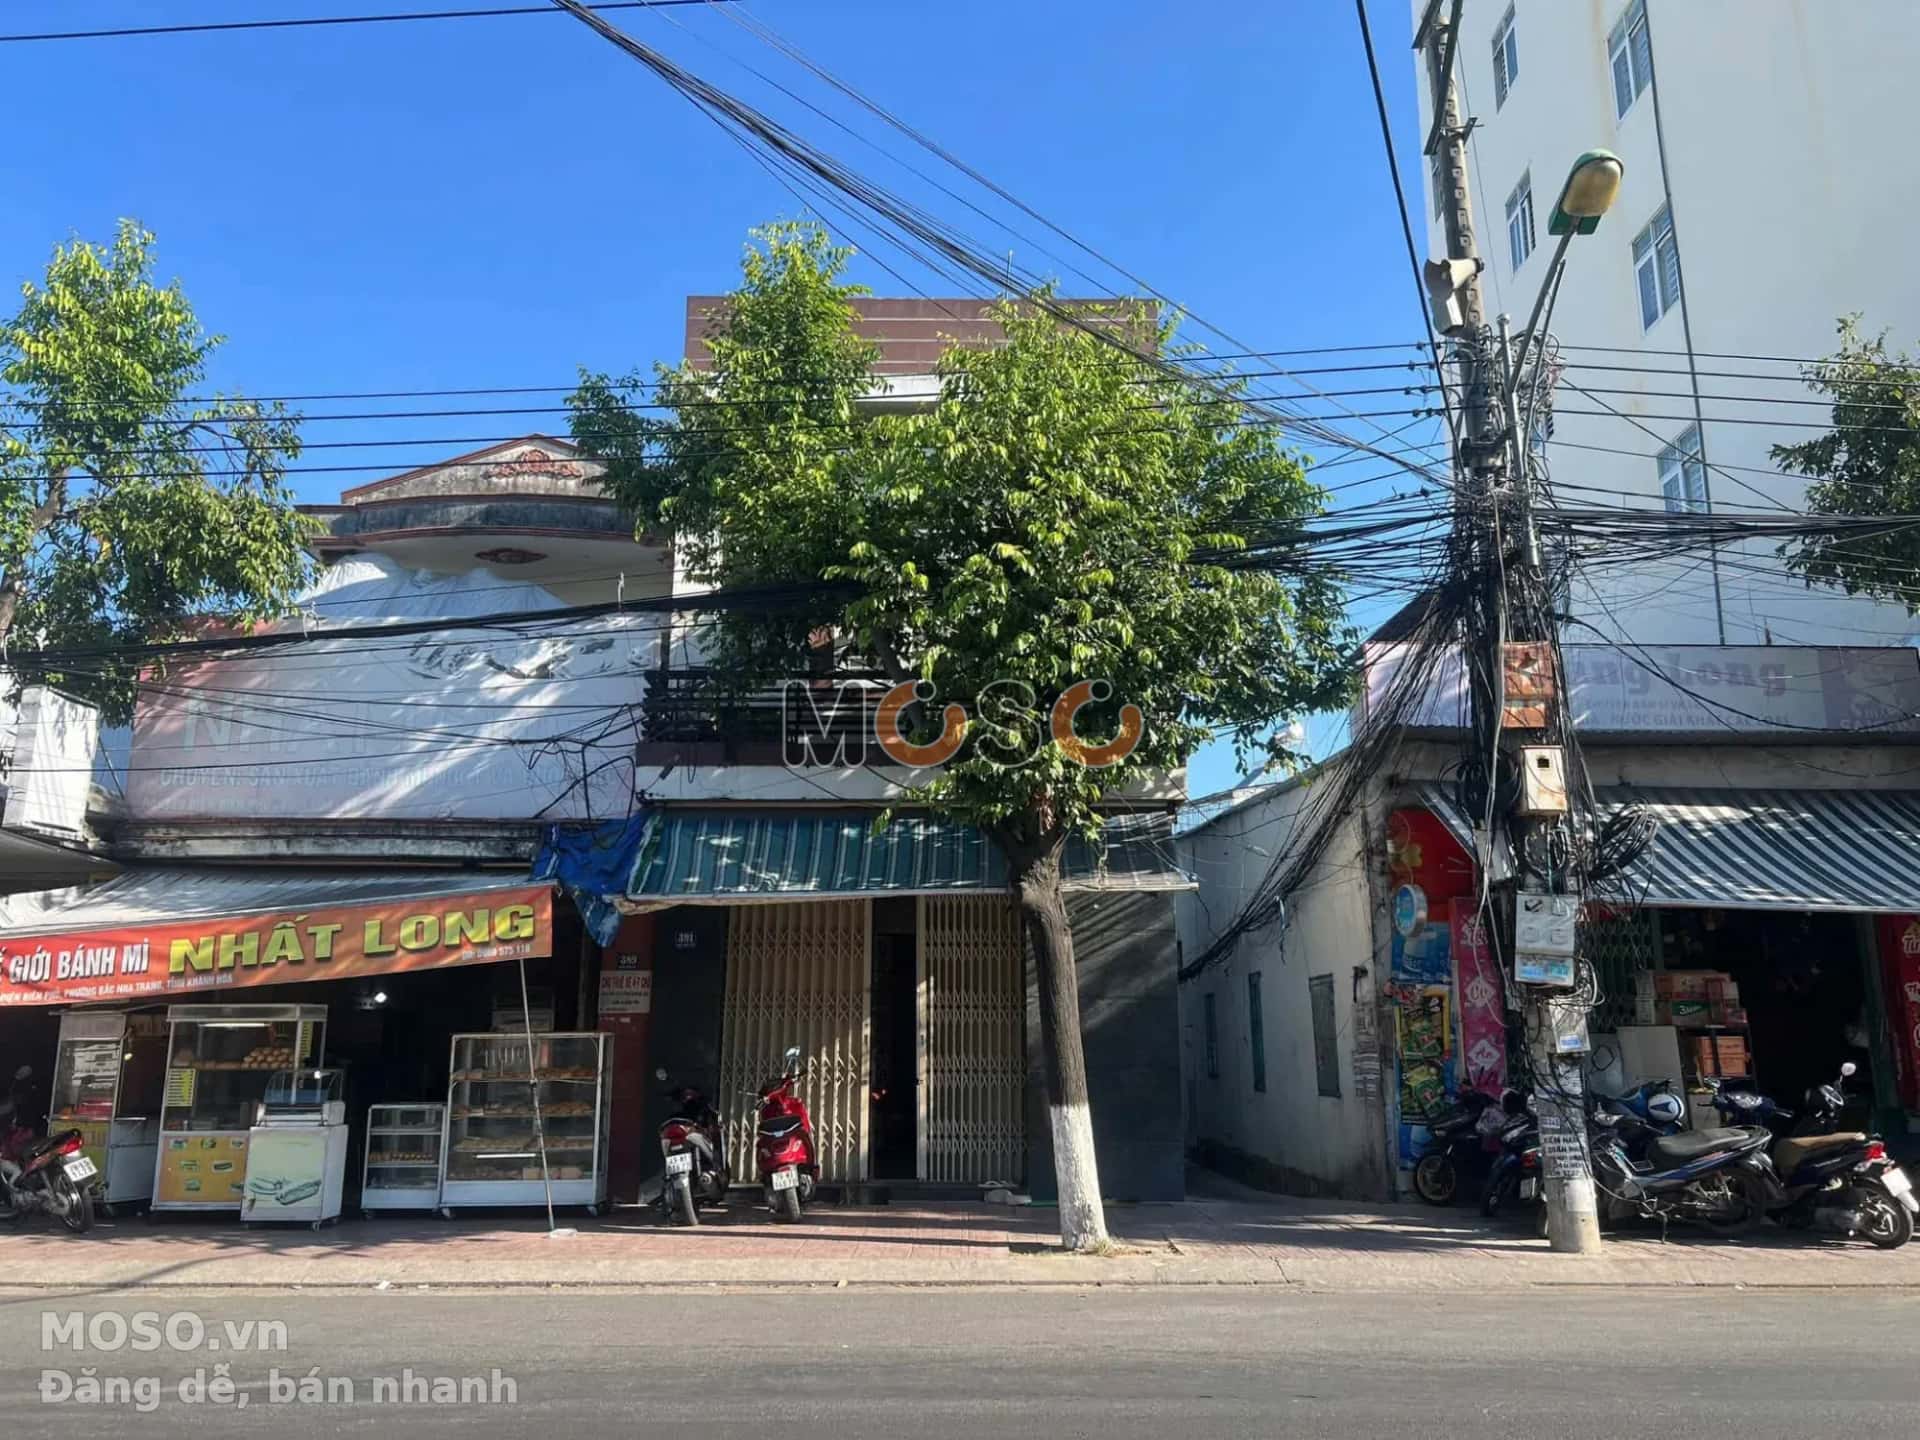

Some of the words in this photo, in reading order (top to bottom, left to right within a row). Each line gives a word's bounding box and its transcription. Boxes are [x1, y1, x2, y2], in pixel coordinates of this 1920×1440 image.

[9, 945, 52, 983] GIỚI
[57, 943, 116, 980] BÁNH
[169, 915, 343, 973] NHẤT
[363, 904, 536, 956] LONG
